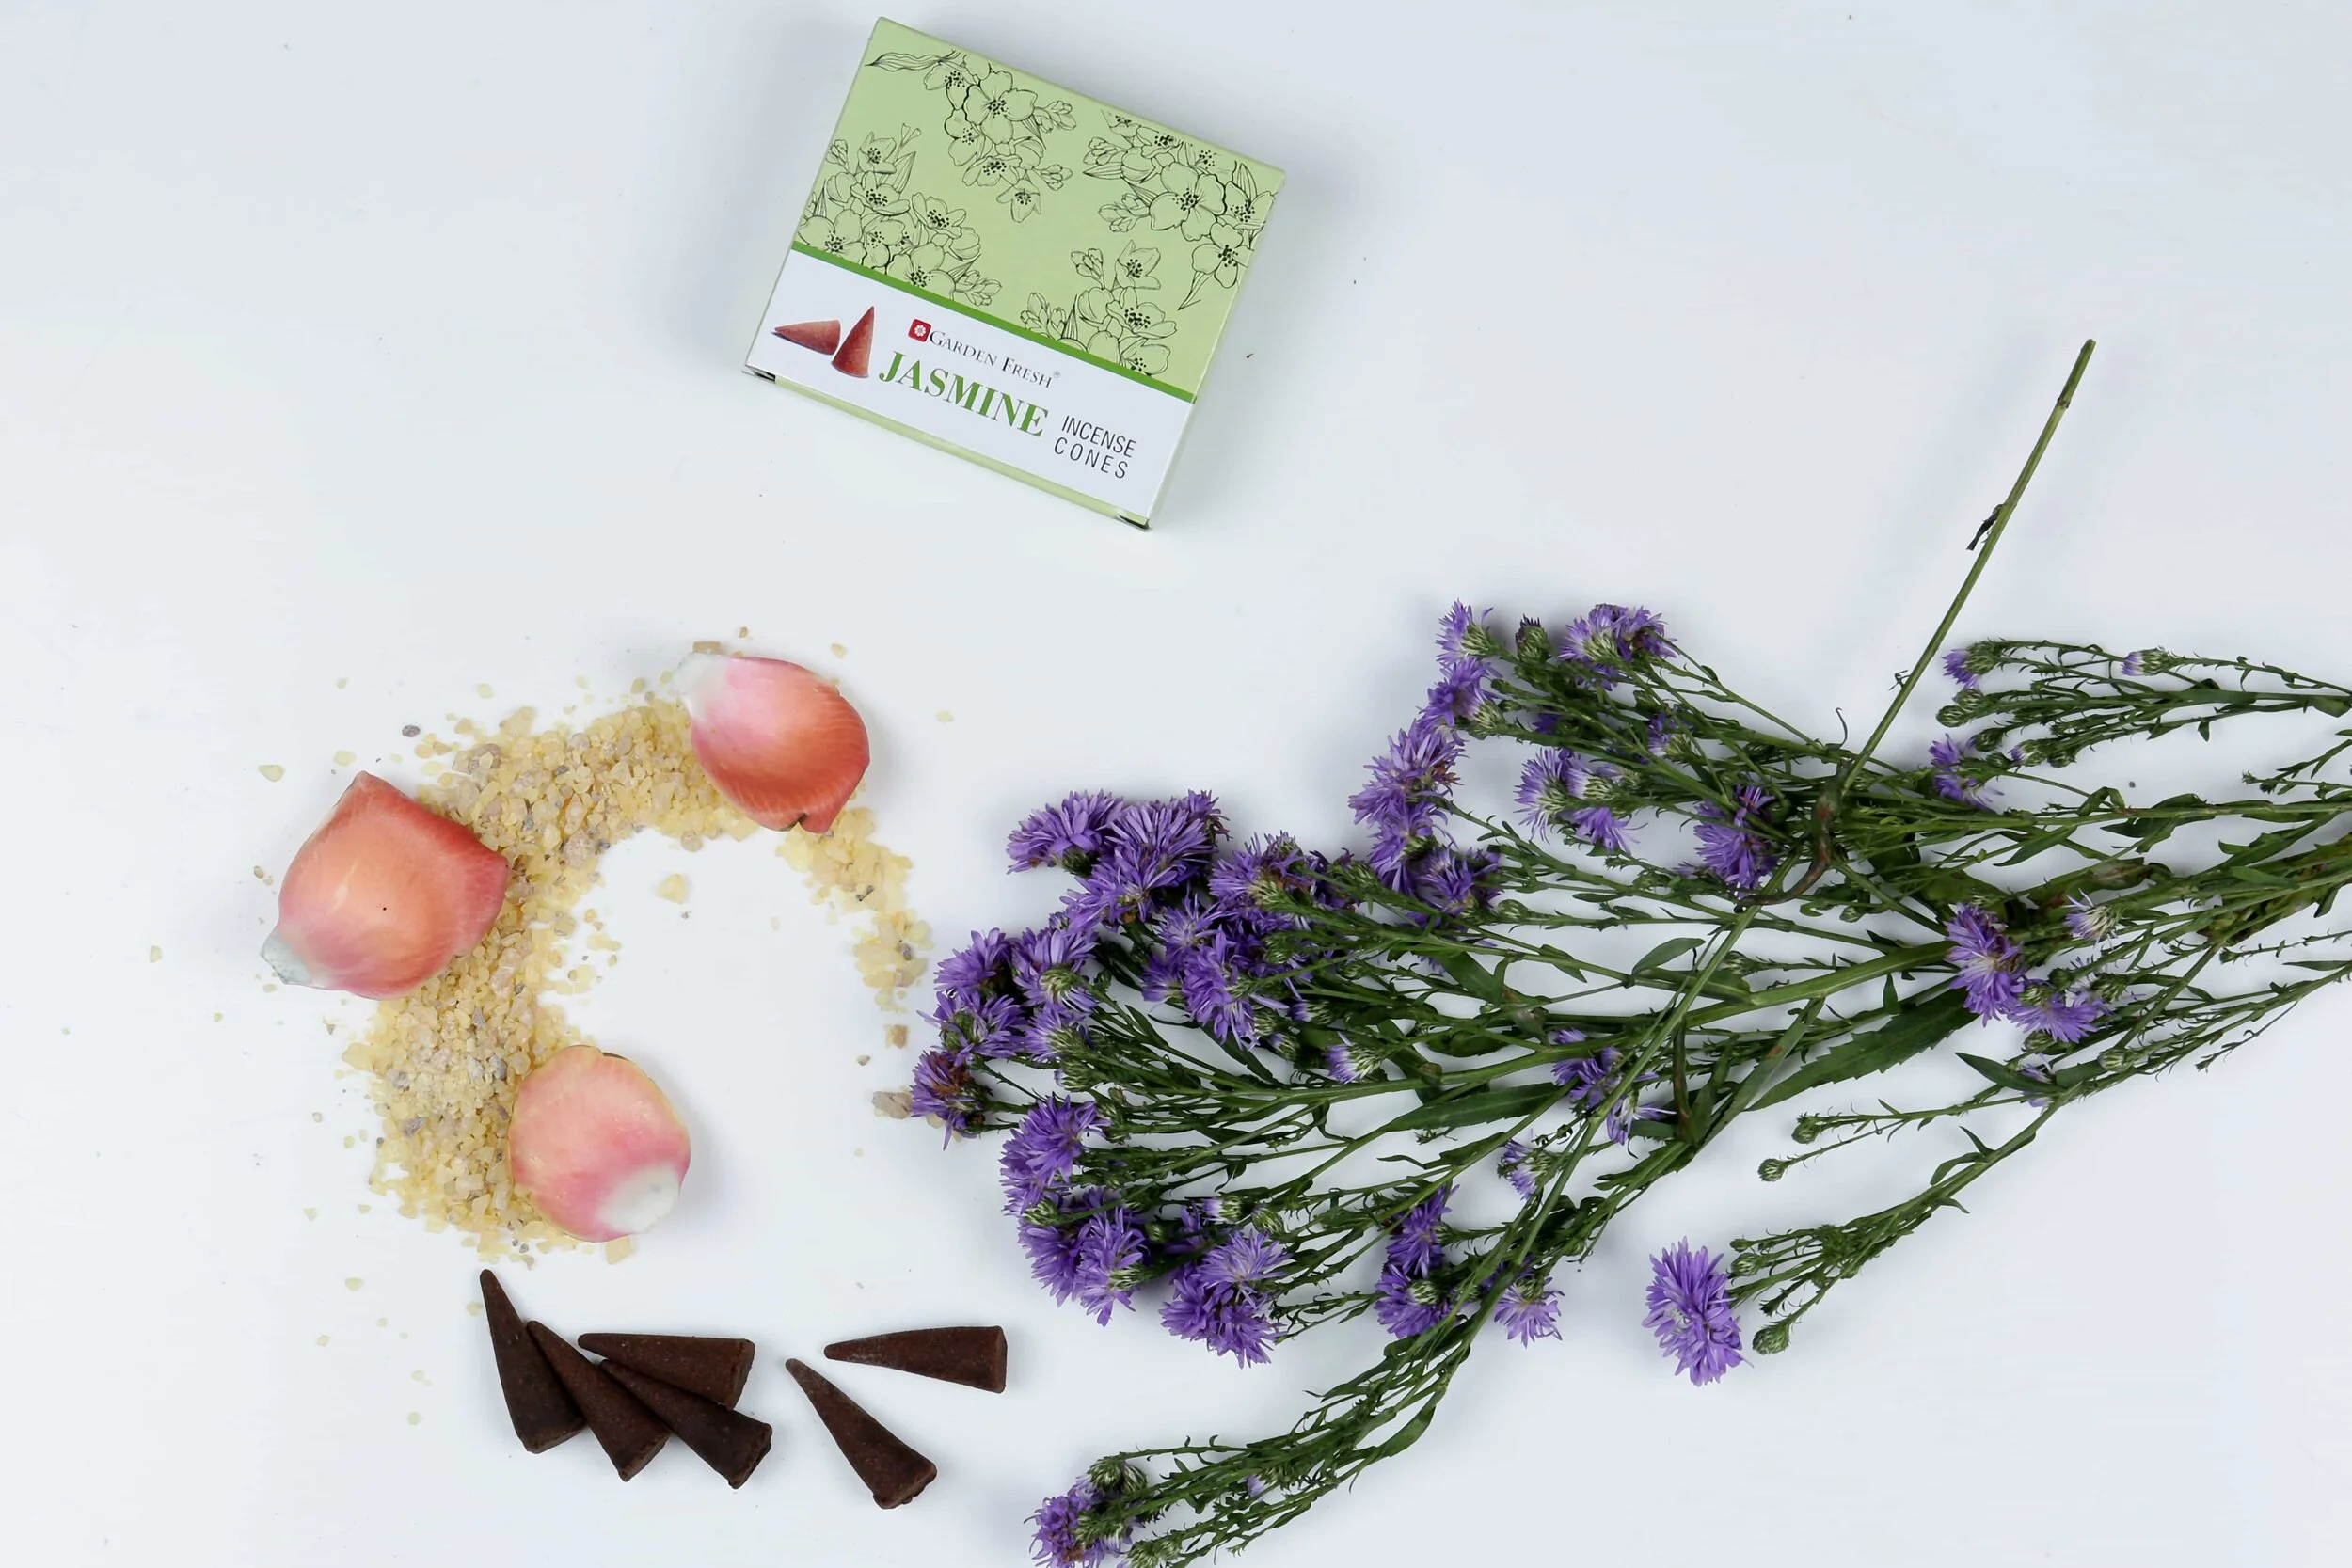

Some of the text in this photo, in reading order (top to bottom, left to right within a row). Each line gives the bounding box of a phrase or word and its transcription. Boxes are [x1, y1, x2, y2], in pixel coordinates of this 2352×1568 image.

[929, 329, 997, 367] GARDEN
[879, 351, 1049, 437] JASMINE
[1061, 415, 1137, 458] INCENSE
[1054, 437, 1129, 479] CONES
